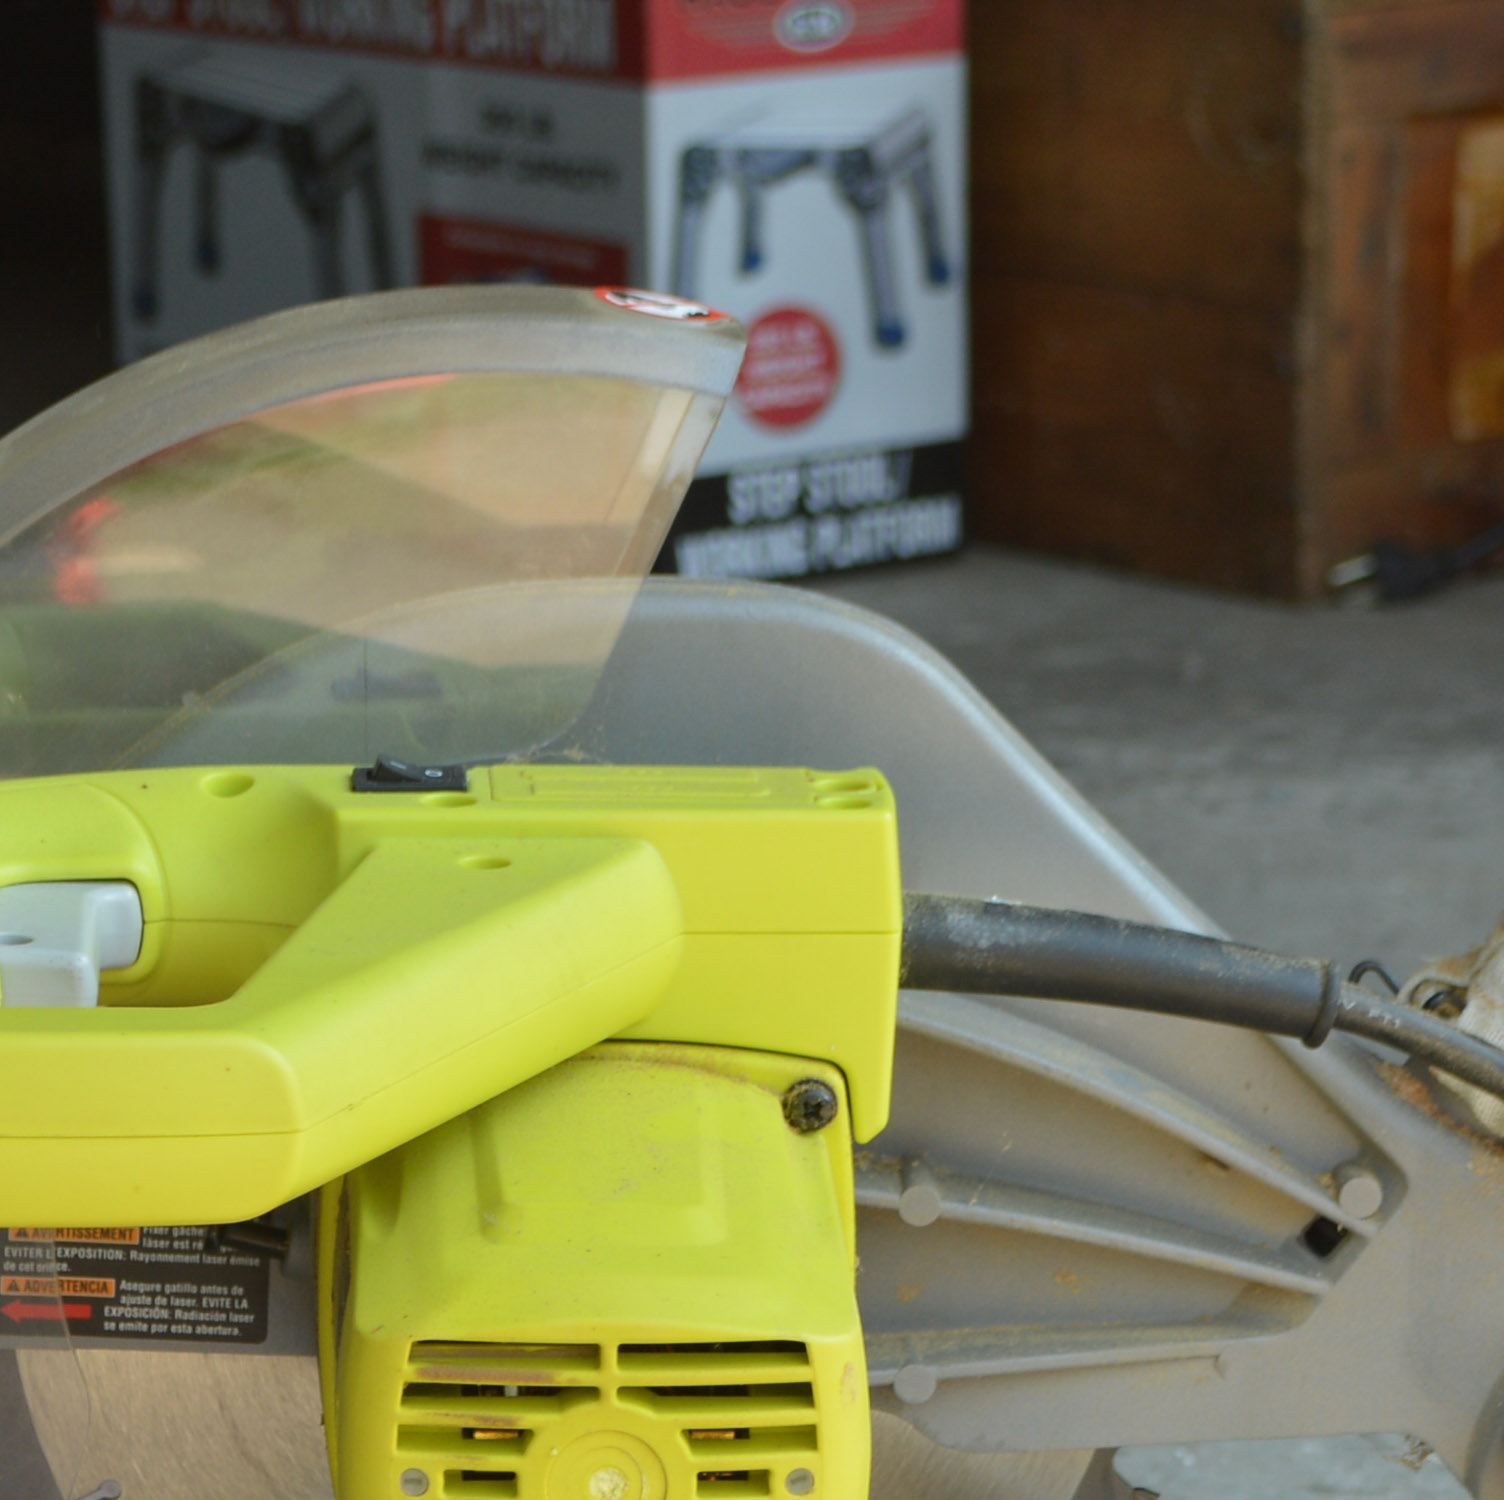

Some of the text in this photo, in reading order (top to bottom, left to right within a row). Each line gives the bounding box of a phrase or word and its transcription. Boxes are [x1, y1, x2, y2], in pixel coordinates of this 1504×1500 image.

[727, 467, 801, 525] STEP
[129, 1250, 200, 1264] Rayonnement
[23, 1278, 109, 1294] ADVERTENCIA
[119, 1280, 244, 1297] Asegure gatillo antes de
[120, 1295, 152, 1307] ajuste
[154, 1295, 167, 1306] de
[202, 1297, 231, 1309] EVITE
[234, 1299, 248, 1310] LA
[174, 1308, 227, 1322] Radiación
[229, 1312, 255, 1323] laser
[103, 1321, 243, 1337] se emite por esta abertura.
